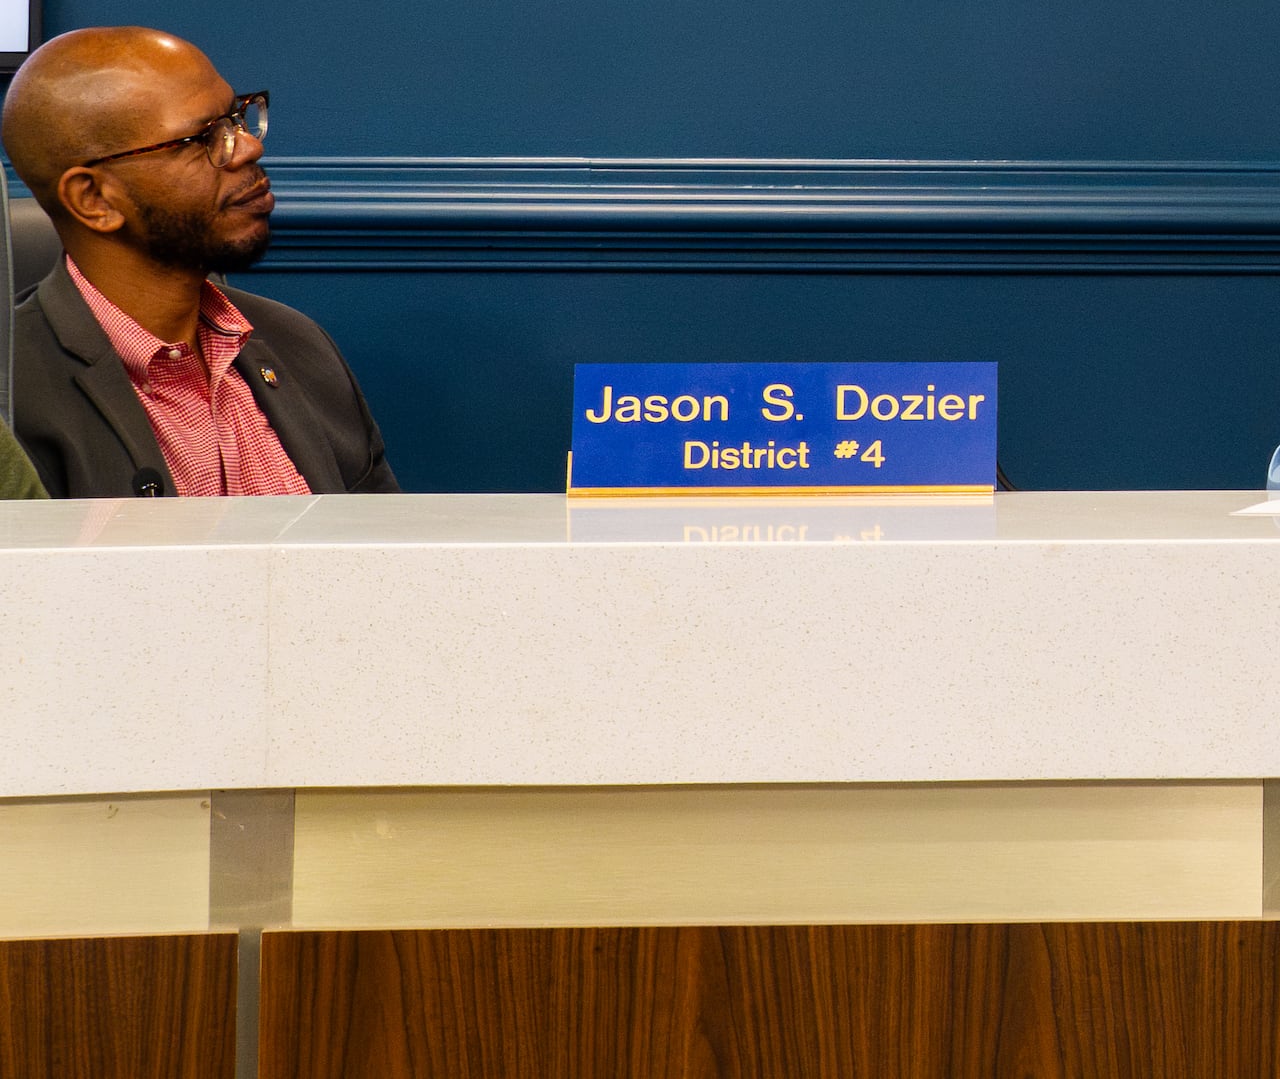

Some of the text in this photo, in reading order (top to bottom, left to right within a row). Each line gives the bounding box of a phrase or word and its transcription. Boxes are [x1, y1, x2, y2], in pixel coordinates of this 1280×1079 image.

[585, 383, 986, 423] Jason S. Dozier
[684, 440, 886, 470] District #4
